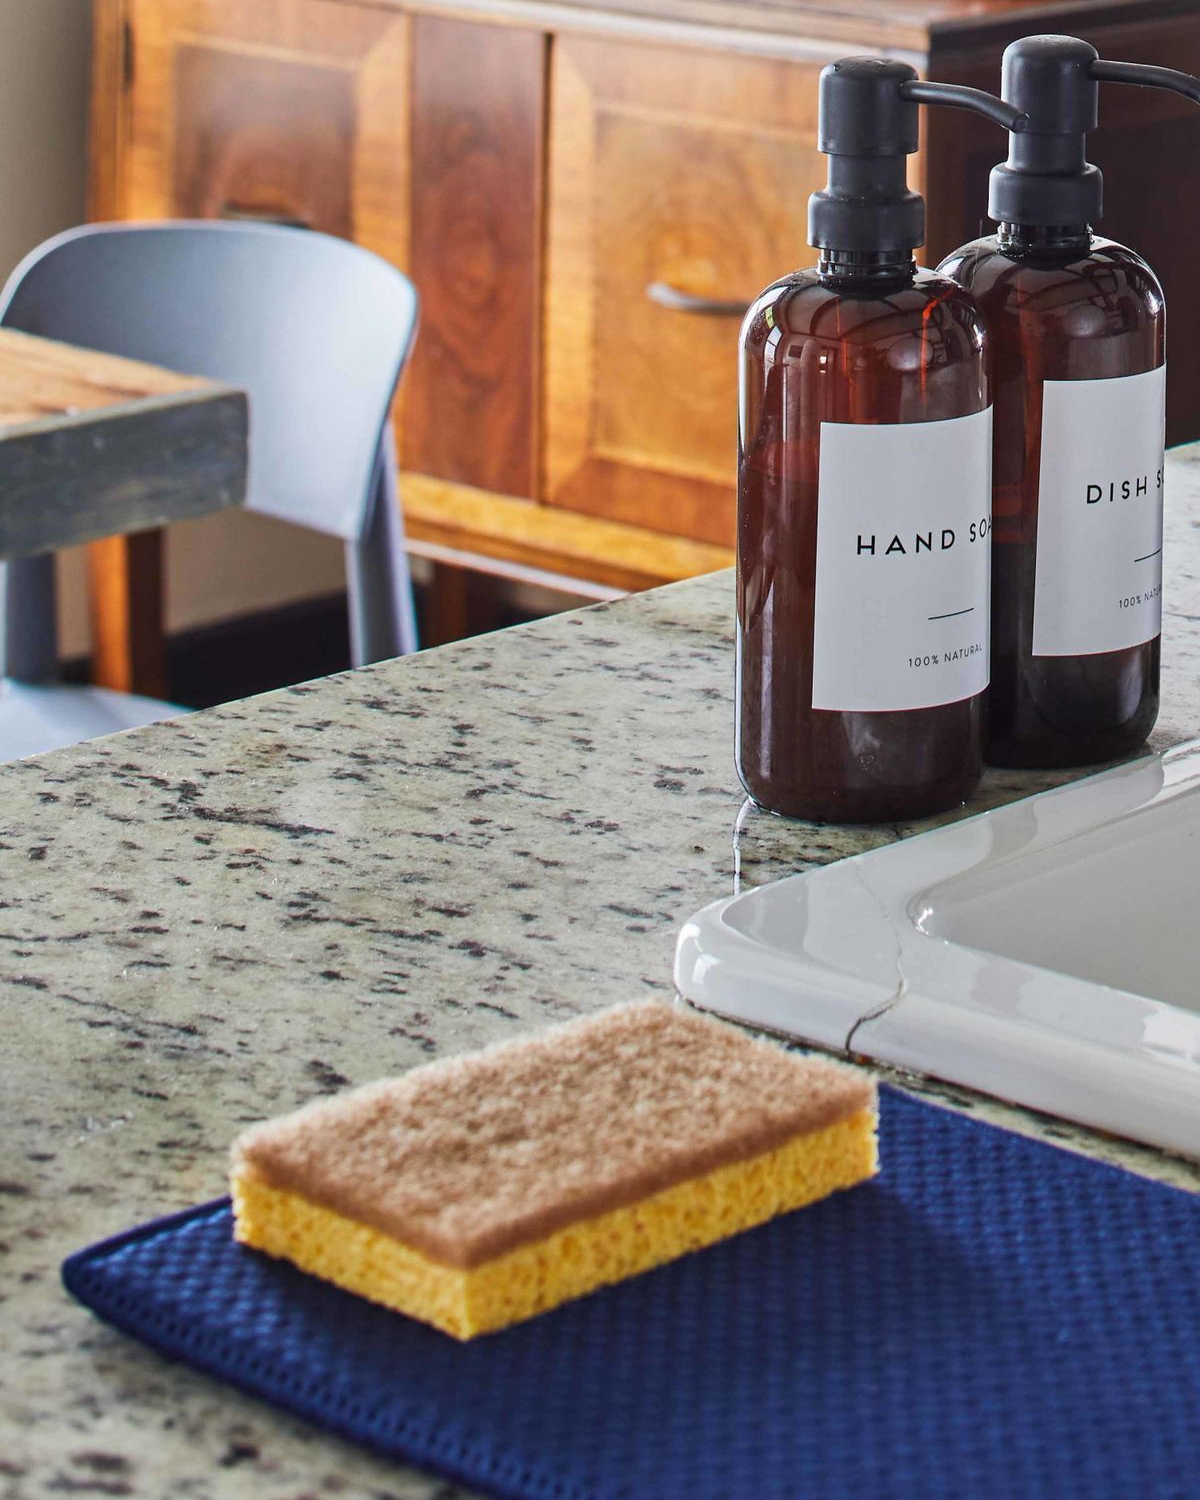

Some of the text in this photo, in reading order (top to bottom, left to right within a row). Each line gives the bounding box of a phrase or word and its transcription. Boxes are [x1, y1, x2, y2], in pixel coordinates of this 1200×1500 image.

[1086, 475, 1147, 504] DISH
[856, 529, 956, 555] HAND
[1119, 595, 1141, 609] 100%
[908, 642, 983, 668] 100% NATURAL
